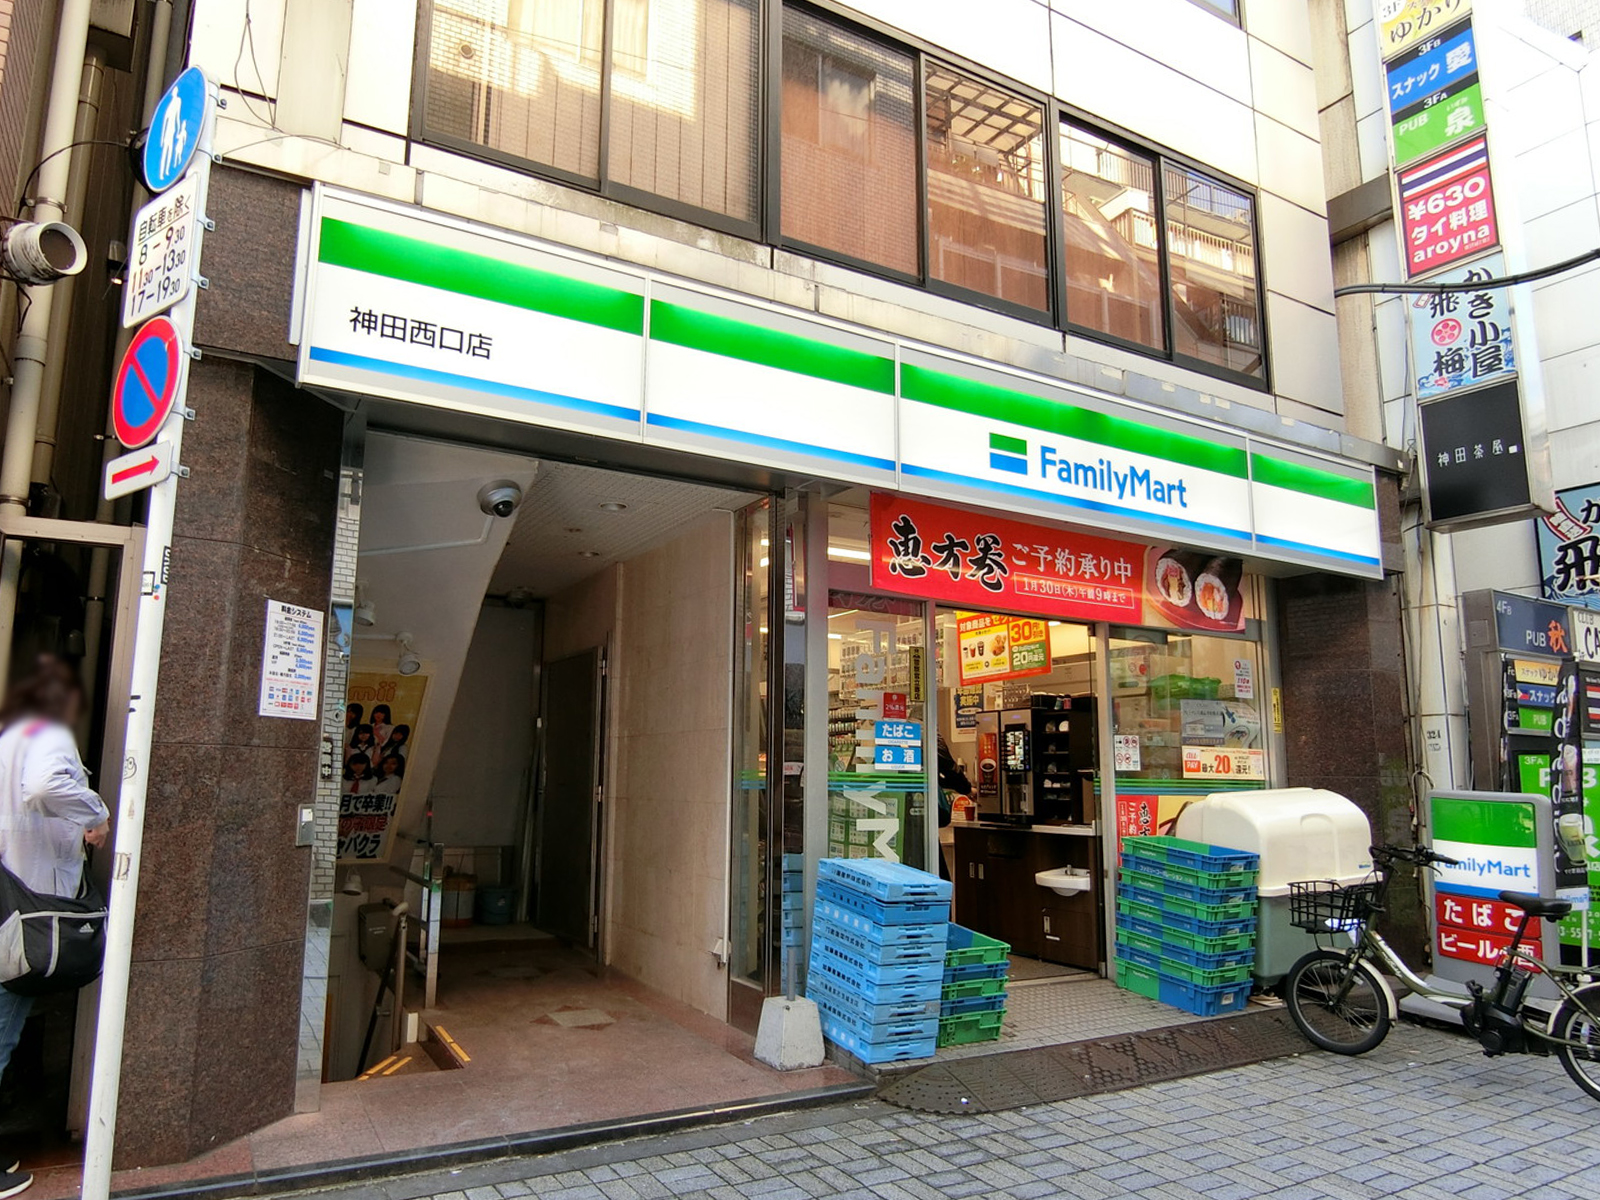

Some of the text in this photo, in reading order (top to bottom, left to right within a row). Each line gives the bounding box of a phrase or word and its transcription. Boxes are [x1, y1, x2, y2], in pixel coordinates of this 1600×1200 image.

[1392, 63, 1440, 100] スナック
[1423, 91, 1448, 109] 3FA
[1399, 105, 1476, 137] PUB 泉
[1408, 176, 1485, 221] ¥630
[138, 194, 192, 242] 自転車を除く
[1411, 198, 1488, 246] タイ料理
[1413, 224, 1490, 264] aroyna
[349, 306, 493, 360] 神田西口店
[1437, 438, 1505, 467] 神田茶屋
[1040, 445, 1188, 508] FamilyMart
[888, 514, 1009, 592] 恵方巻
[1011, 542, 1132, 585] ご予約承り中
[281, 605, 312, 619] 料金システム
[1496, 600, 1512, 616] 4FB
[1010, 620, 1032, 643] 30
[1526, 620, 1568, 653] PUB 秋
[882, 723, 915, 738] たばこ
[1532, 714, 1547, 725] PUB
[881, 748, 915, 763] お酒
[1524, 756, 1544, 766] 3FA
[1539, 766, 1597, 789] PB
[1444, 898, 1527, 933] たばこ
